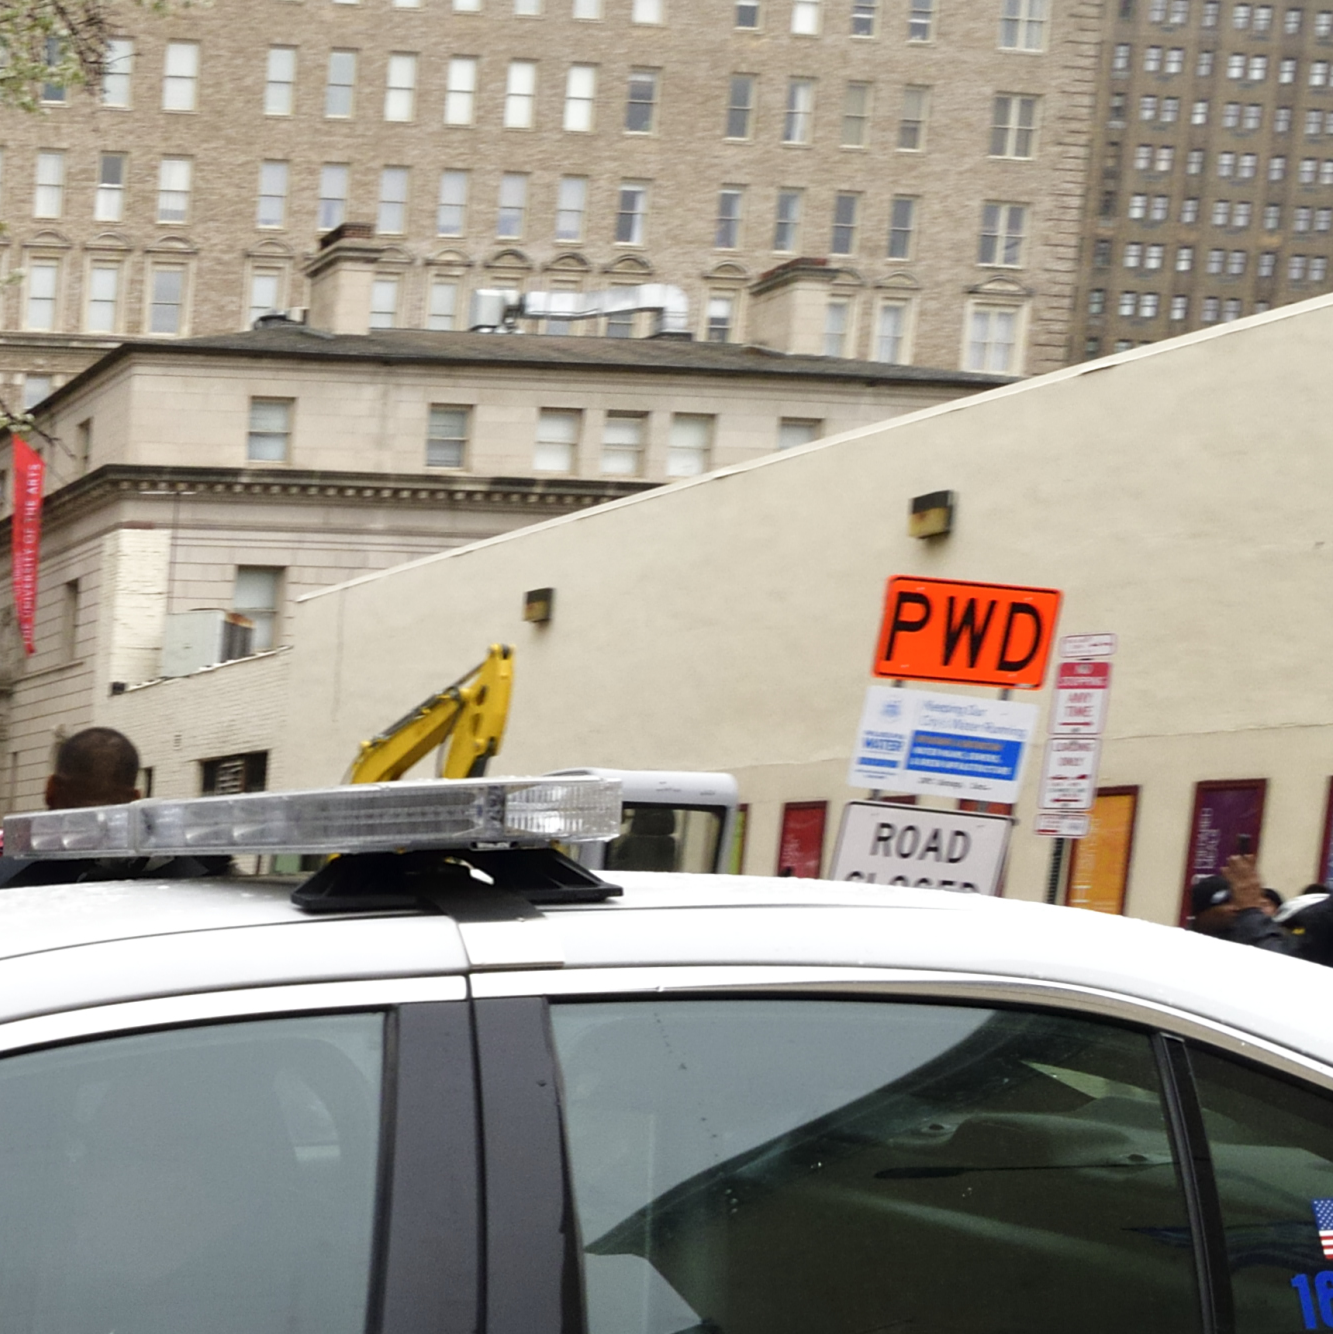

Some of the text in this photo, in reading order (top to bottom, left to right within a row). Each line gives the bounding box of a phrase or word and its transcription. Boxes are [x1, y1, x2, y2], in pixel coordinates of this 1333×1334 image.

[27, 463, 43, 494] ARTS
[25, 500, 40, 523] THE
[23, 526, 36, 545] OF
[885, 591, 1042, 672] PWD
[1064, 705, 1094, 717] TIME
[869, 822, 971, 863] ROAD
